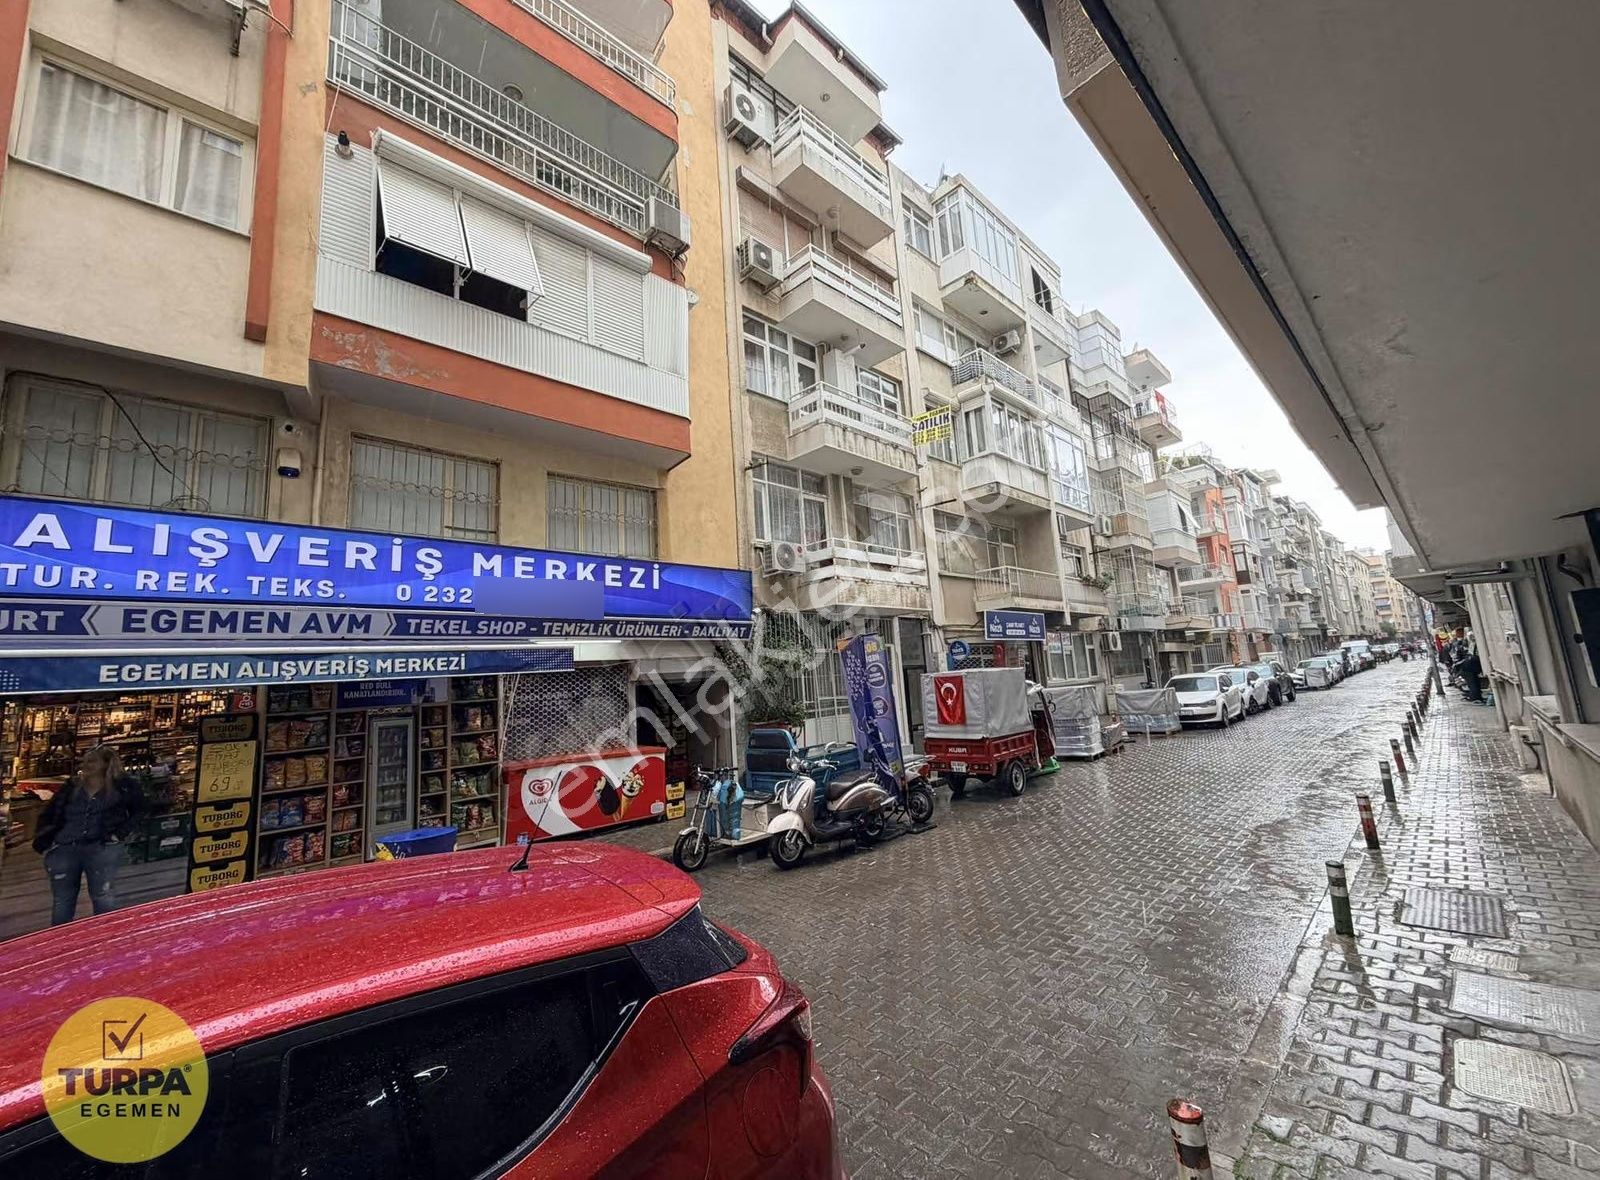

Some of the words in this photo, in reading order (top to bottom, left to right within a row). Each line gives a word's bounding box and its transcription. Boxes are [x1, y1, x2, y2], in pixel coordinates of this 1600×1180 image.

[911, 412, 950, 432] SATILIK
[13, 512, 443, 581] ALIŞVERİŞ
[472, 551, 661, 590] MERKEZİ
[135, 569, 230, 594] REK.
[246, 575, 346, 599] TEKS.
[396, 583, 412, 602] 0
[423, 585, 473, 604] 232
[121, 608, 291, 635] EGEMEN
[299, 612, 372, 635] AVM
[406, 618, 472, 636] TEKEL
[477, 621, 526, 637] SHOP
[99, 662, 229, 684] EGEMEN
[236, 655, 370, 681] ALIŞVERİŞ
[376, 653, 466, 674] MERKEZİ
[201, 811, 243, 824] TUBORG
[200, 841, 241, 854] TUBORG
[197, 870, 239, 884] TUBORG
